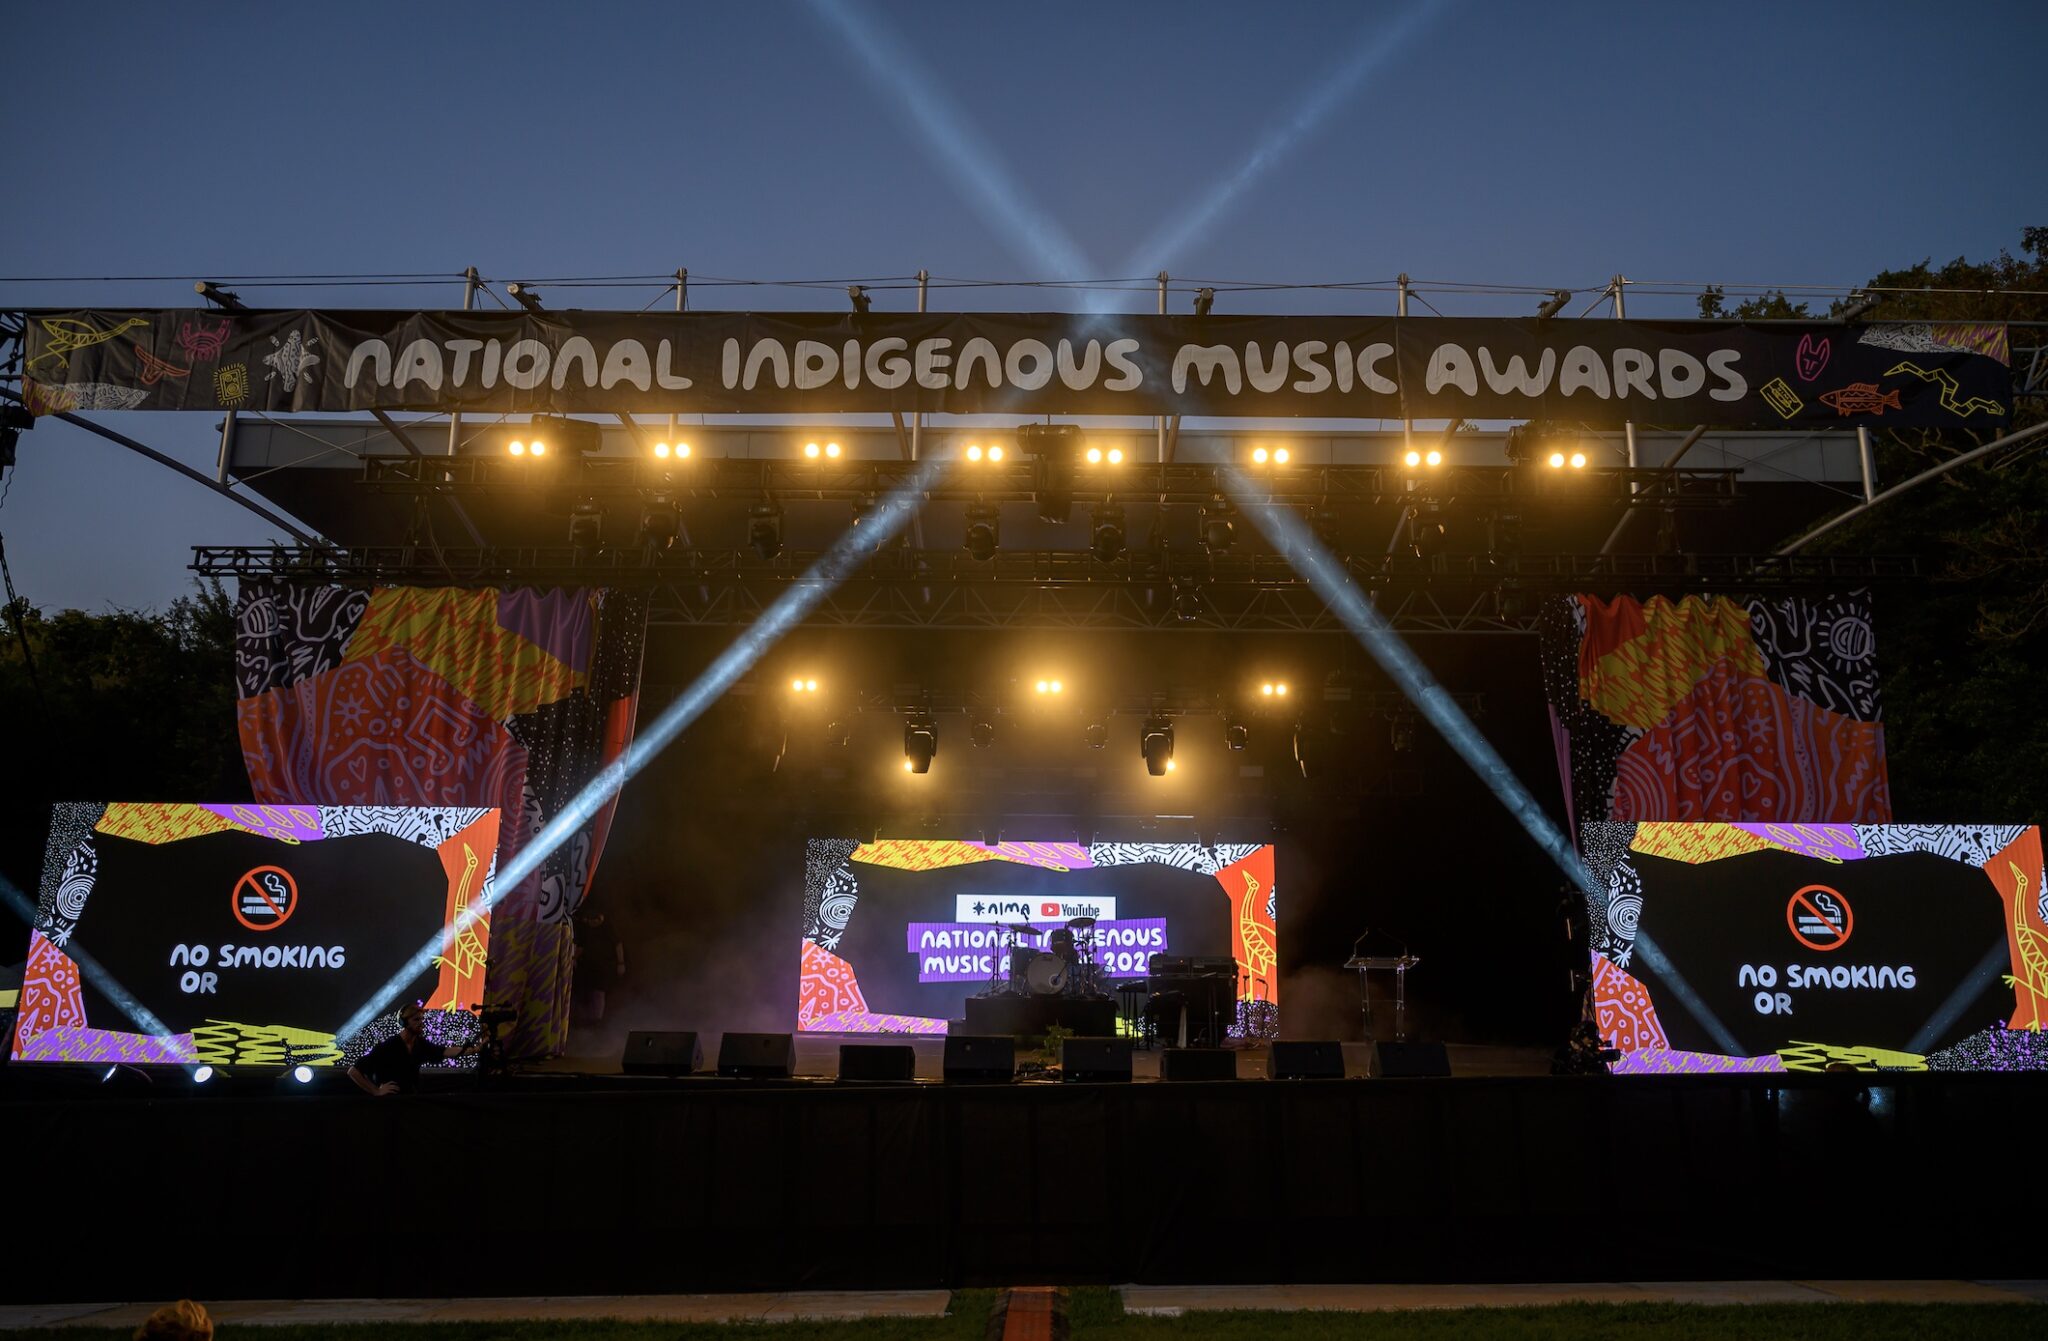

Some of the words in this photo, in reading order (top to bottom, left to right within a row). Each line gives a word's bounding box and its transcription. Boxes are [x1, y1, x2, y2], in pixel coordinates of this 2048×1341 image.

[343, 335, 693, 391] NATIONAL
[721, 336, 1144, 393] INDIGENOUS
[1171, 339, 1399, 396] MUSIC
[1425, 342, 1749, 402] AWARDS
[1061, 903, 1100, 917] YouTube
[920, 930, 1028, 949] NATIONAL
[169, 943, 210, 968] NO
[217, 944, 347, 969] SMOKING
[923, 954, 992, 975] MUSIC
[1103, 950, 1160, 973] 202
[180, 970, 218, 995] OR
[1738, 963, 1778, 988] NO
[1786, 964, 1918, 989] SMOKING
[1753, 991, 1794, 1016] OR
